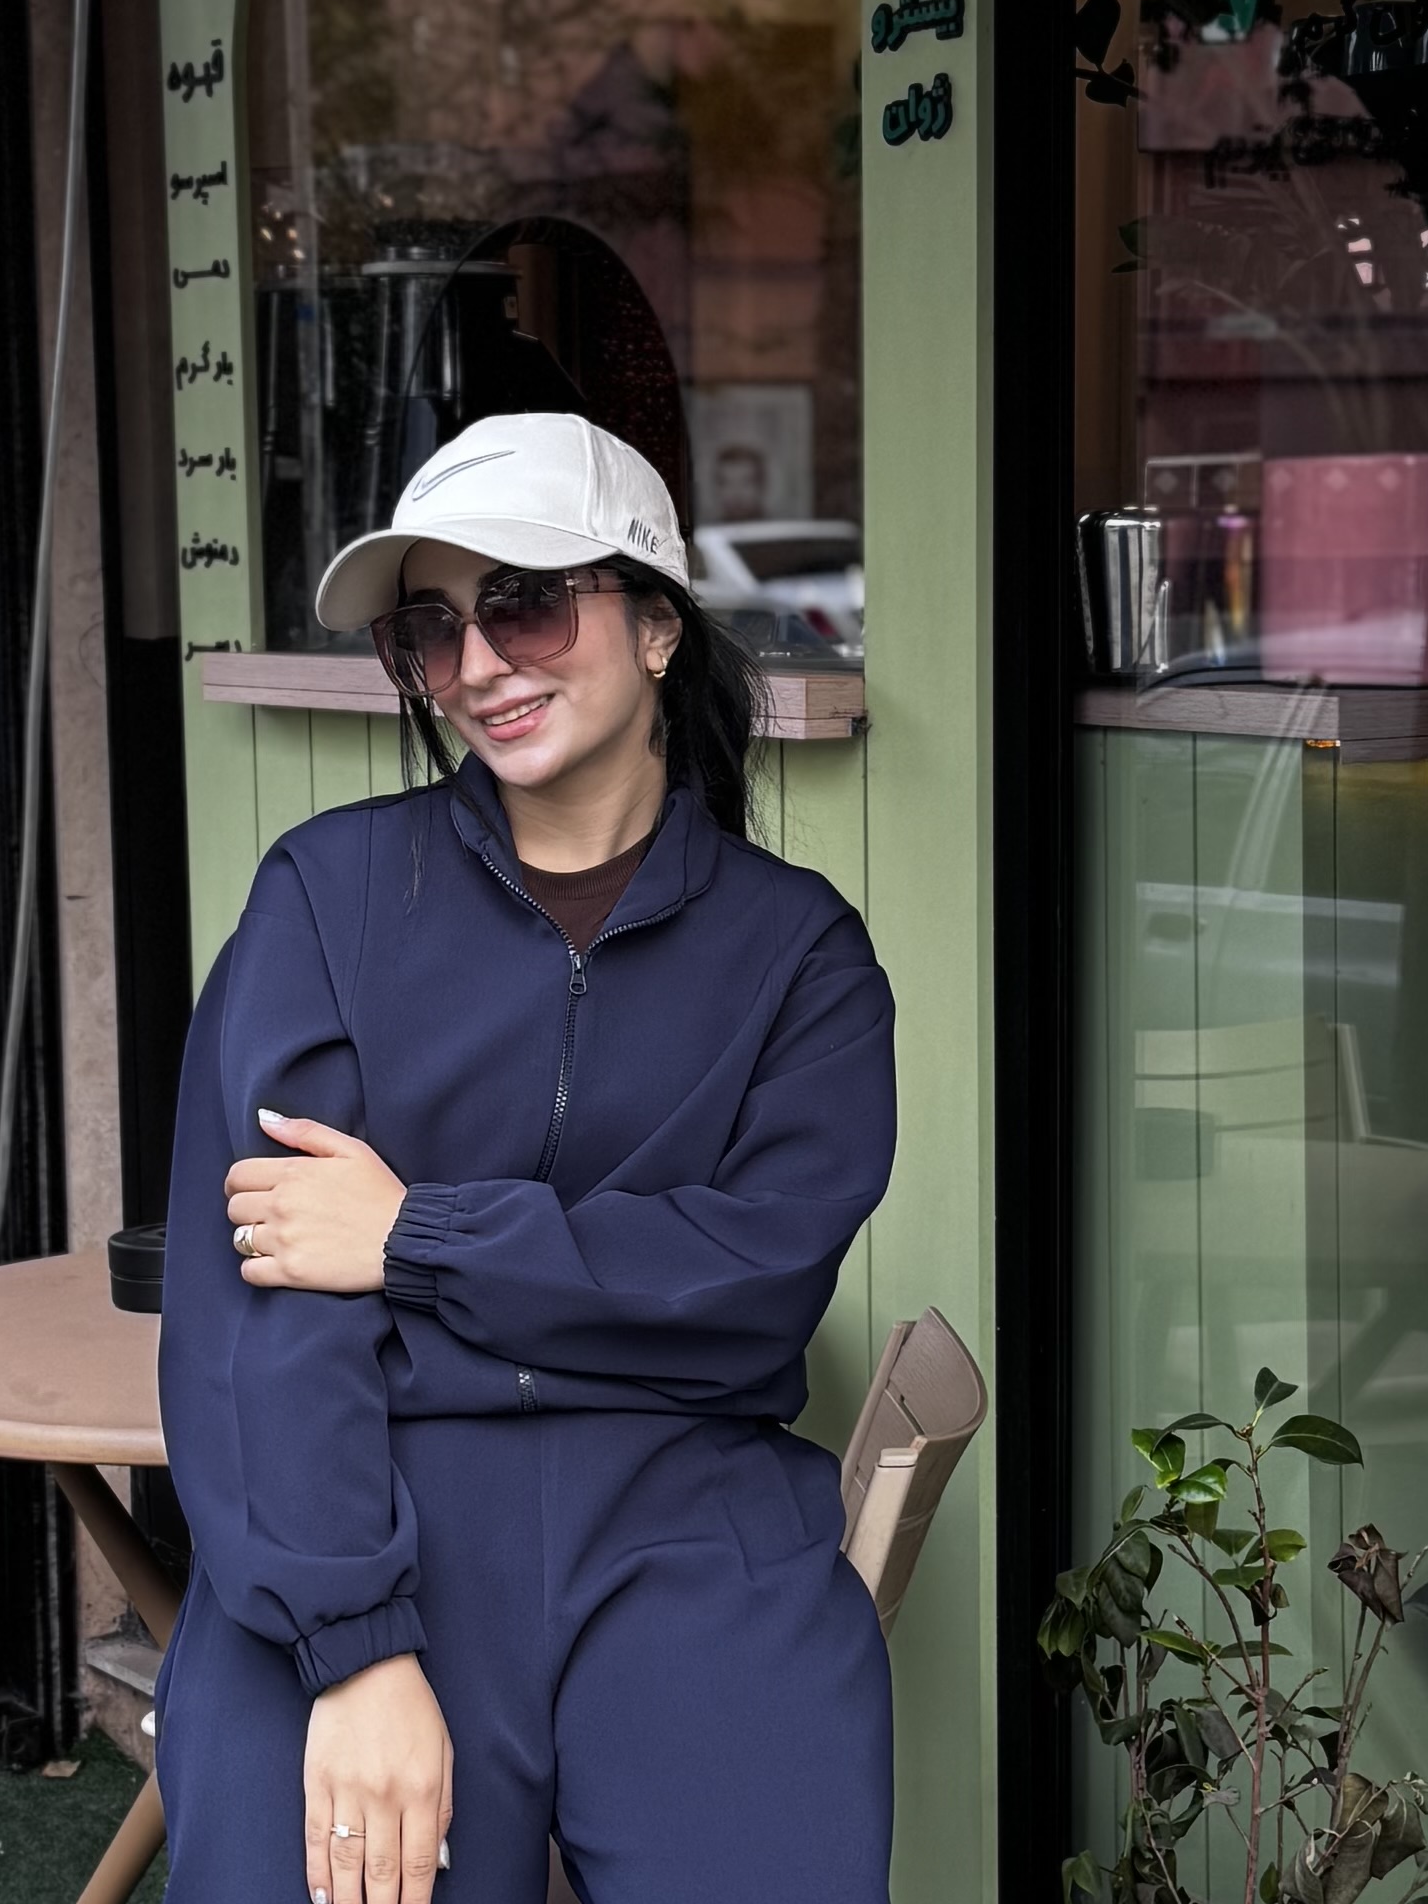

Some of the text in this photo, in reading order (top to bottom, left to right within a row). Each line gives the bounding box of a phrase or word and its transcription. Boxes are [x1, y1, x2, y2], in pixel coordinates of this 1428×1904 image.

[167, 38, 224, 104] قهوه
[883, 72, 953, 147] ژوان
[170, 160, 229, 206] اسپرسو
[173, 258, 231, 289] دمی
[175, 340, 234, 391] بار گرم
[177, 447, 237, 482] بار سرد
[180, 531, 240, 570] دمنوش
[627, 517, 660, 556] NIKE
